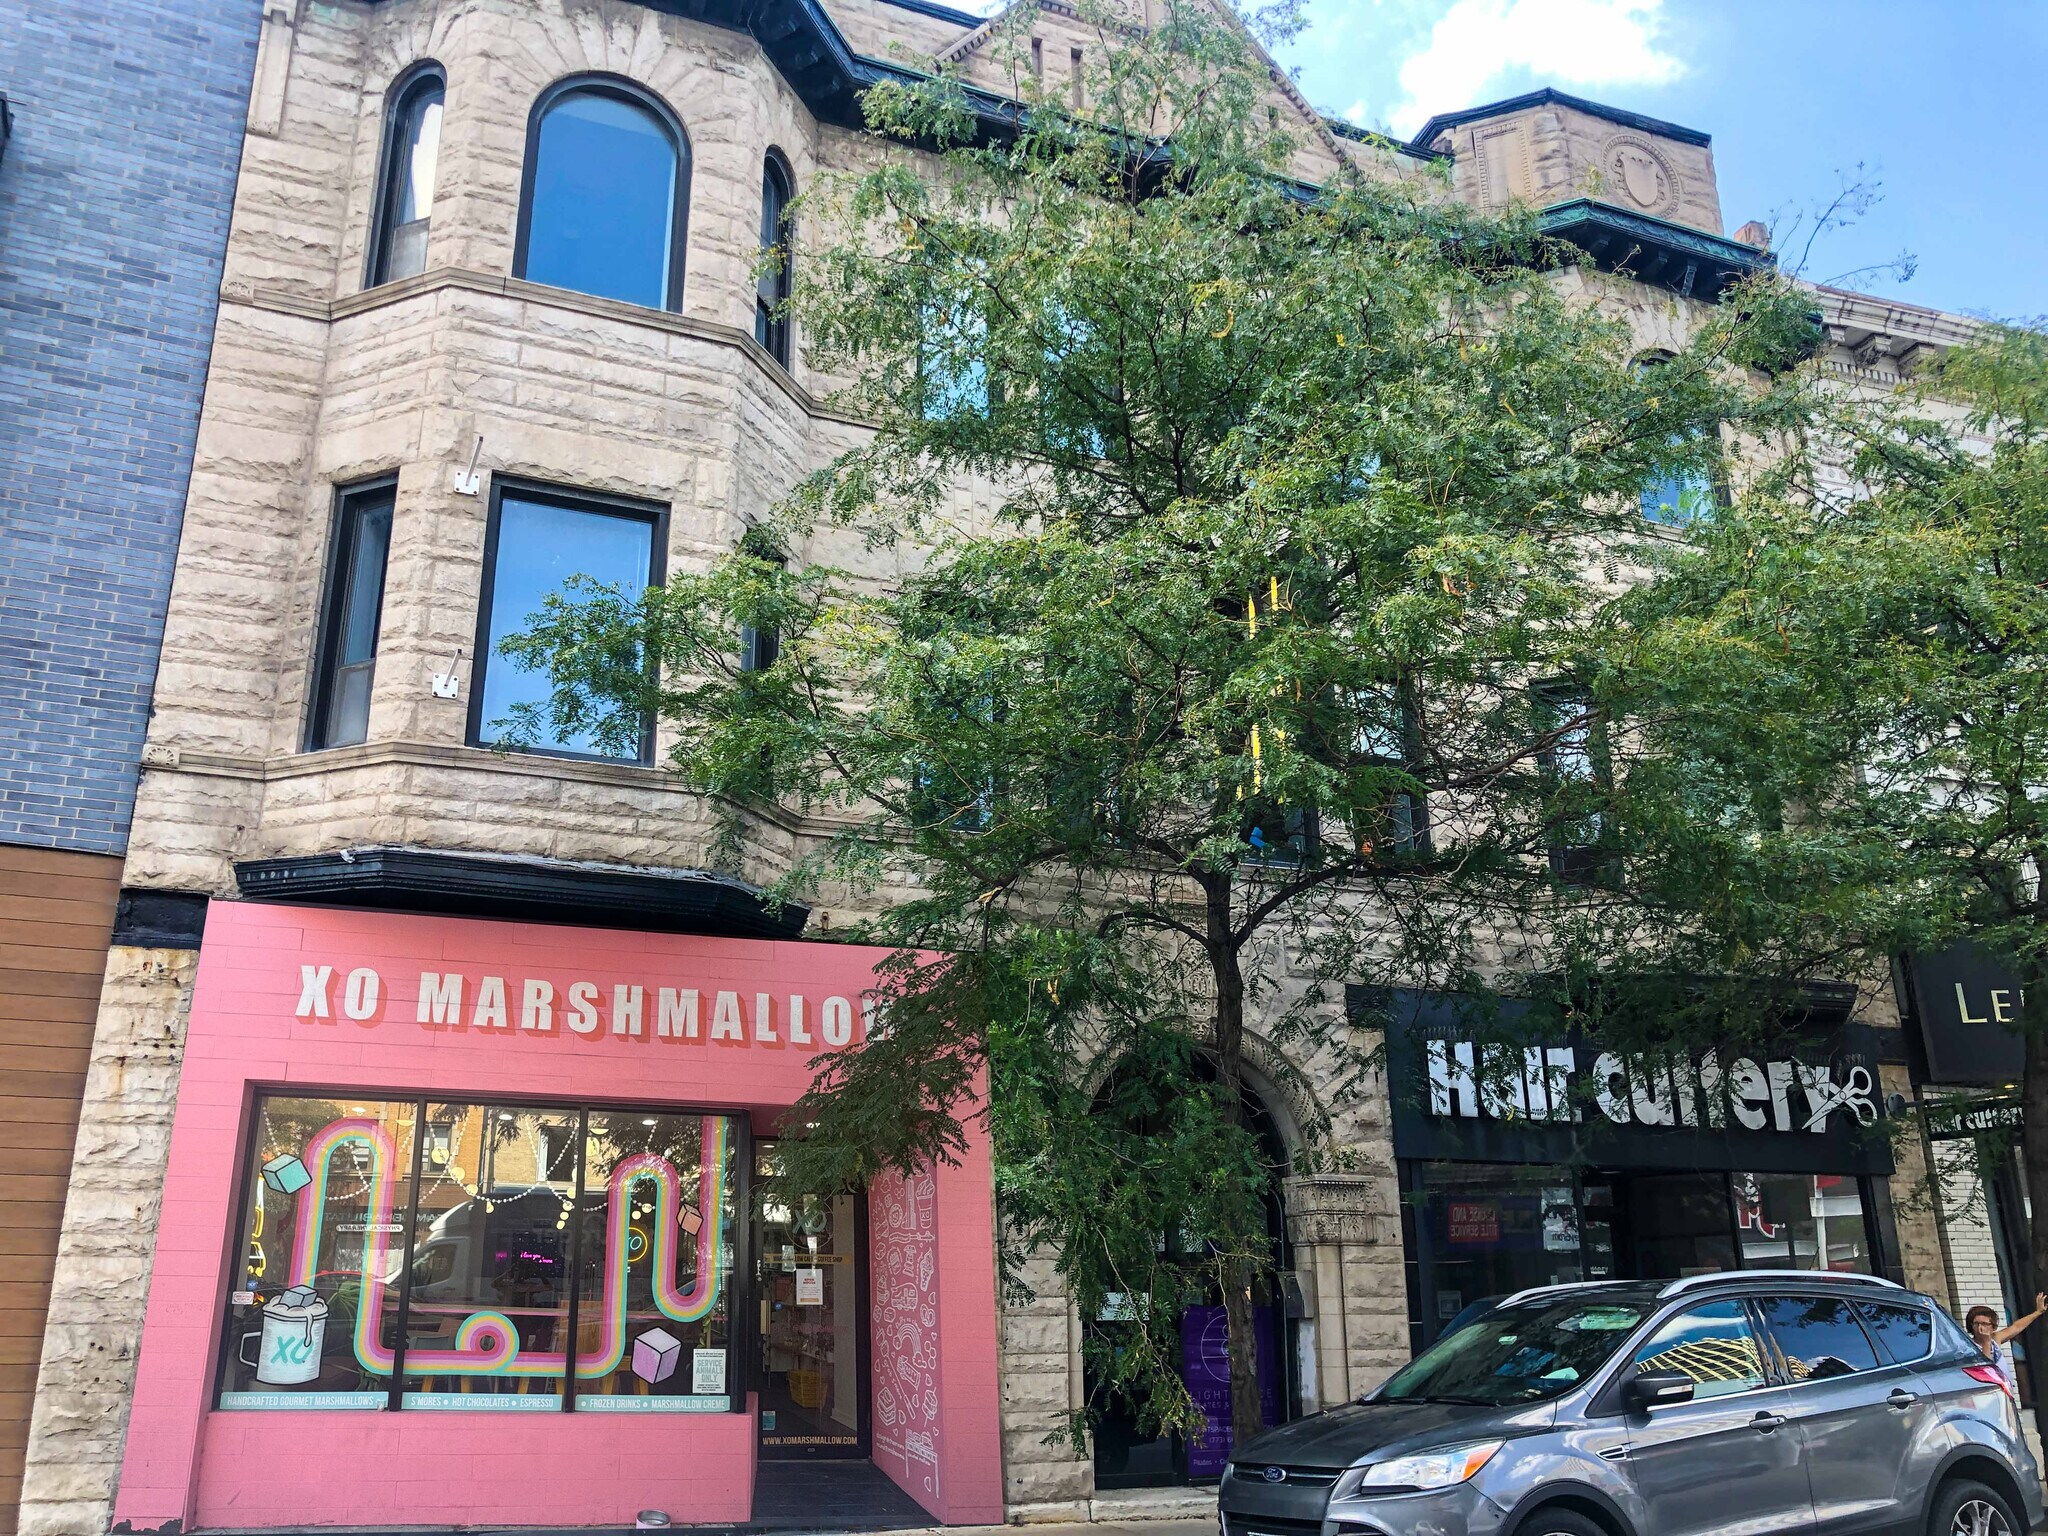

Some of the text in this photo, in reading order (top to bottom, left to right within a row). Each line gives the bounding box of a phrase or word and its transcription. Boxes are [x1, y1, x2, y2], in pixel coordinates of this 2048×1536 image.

[295, 965, 381, 1021] XO
[1955, 982, 2025, 1023] LE
[1427, 1040, 1576, 1122] Hair
[269, 1336, 315, 1364] XO
[696, 1359, 723, 1367] SERVICE
[695, 1366, 724, 1374] ANIMALS
[701, 1374, 718, 1382] ONLY
[227, 1395, 374, 1406] HANDCRAFTED GOURMET MARSHMALLOWS
[411, 1396, 554, 1408] S'MORES HOT CHOCOLATES ESPRESSO
[589, 1398, 725, 1409] FROZEN DRINKS MARSHMALLOW CREME
[762, 1436, 858, 1446] WWW.XOMARSHMALLOW.COM
